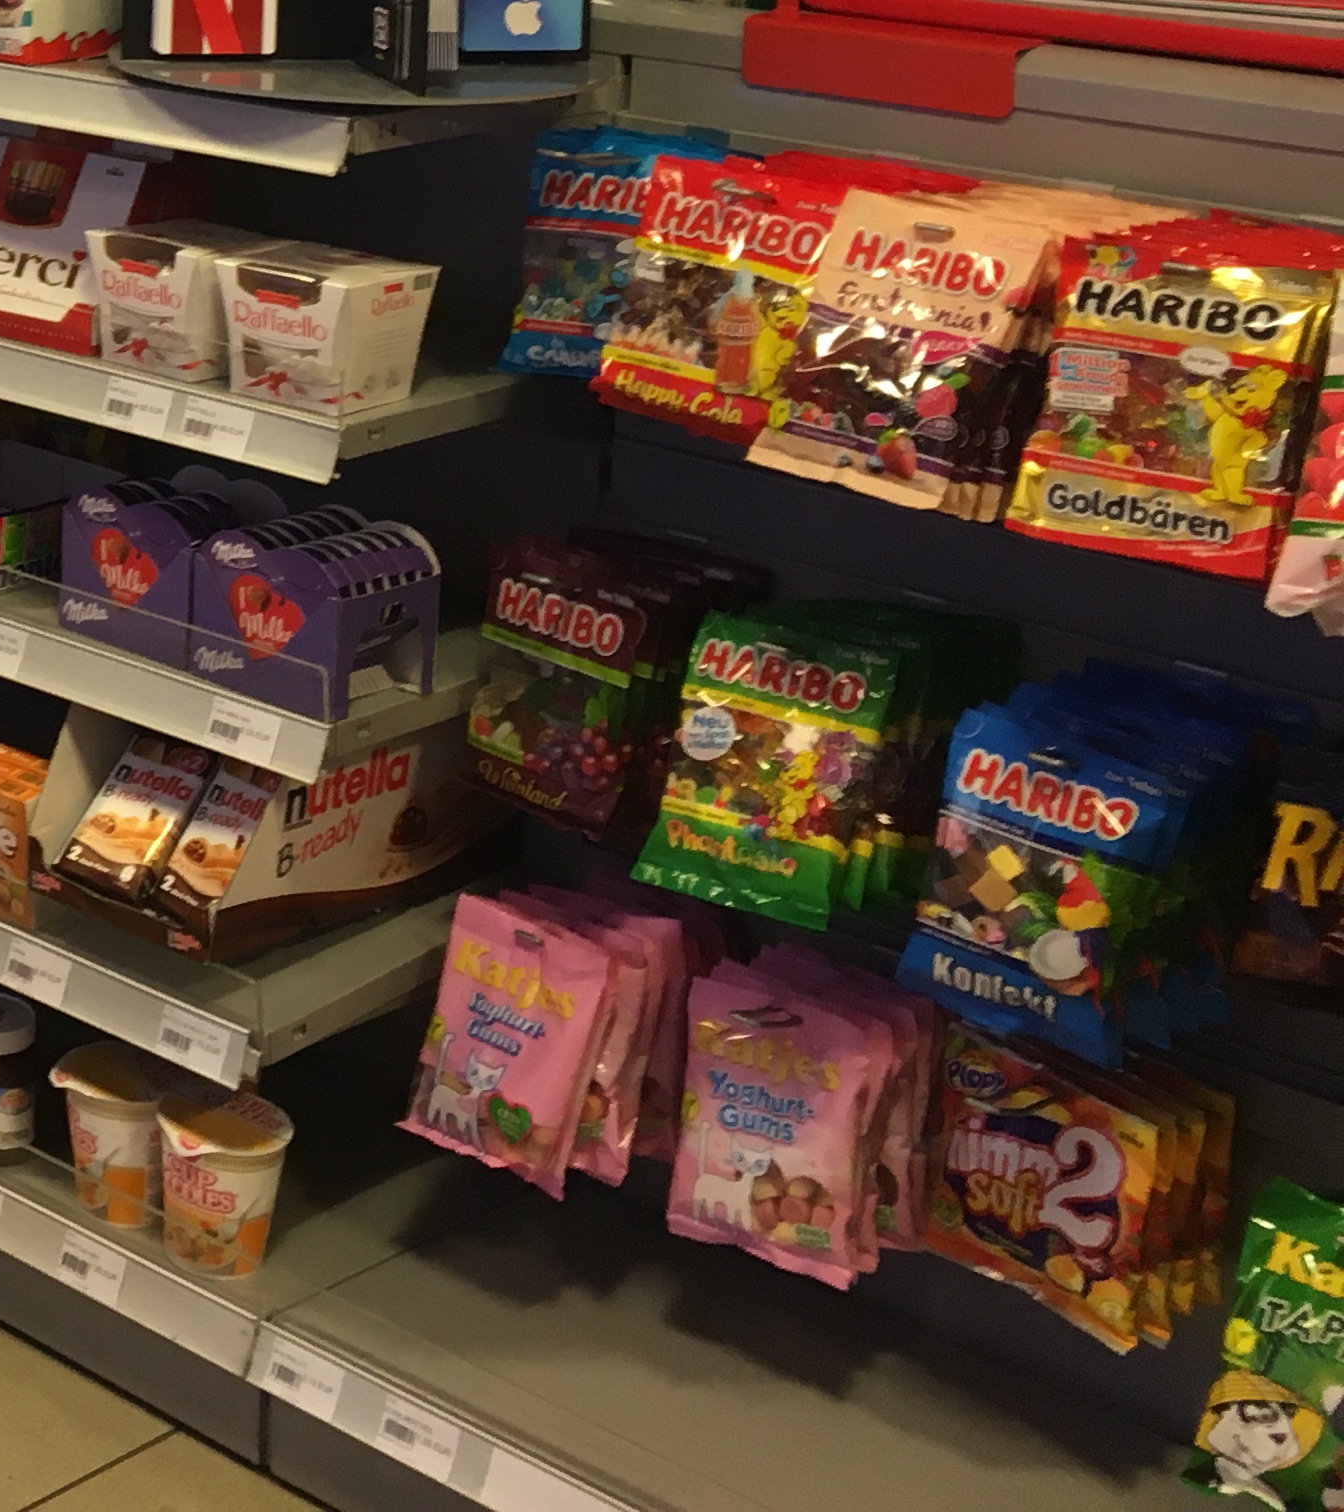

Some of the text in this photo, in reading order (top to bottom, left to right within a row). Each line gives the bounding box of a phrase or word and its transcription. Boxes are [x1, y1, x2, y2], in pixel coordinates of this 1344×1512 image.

[655, 191, 832, 265] HARIBO
[101, 269, 183, 310] Raffaello
[843, 228, 1008, 298] HARIBO
[232, 300, 329, 343] Raffaello
[1074, 279, 1286, 342] HARIBO
[1047, 482, 1233, 544] Goldbären
[63, 598, 109, 623] Milka
[100, 564, 150, 595] Milka
[239, 611, 293, 642] Milka
[495, 578, 625, 657] HARIBO
[194, 646, 245, 671] Milka
[694, 638, 868, 713] HARIBO
[114, 762, 195, 803] nutella
[207, 782, 273, 823] nutell
[282, 746, 414, 830] nutella
[957, 747, 1139, 841] HARIBO
[275, 808, 364, 879] B-ready
[451, 938, 577, 1021] Katjes
[931, 951, 1057, 1021] Konfekt
[466, 1019, 523, 1057] Gums
[694, 1019, 842, 1092] Katjes
[717, 1103, 796, 1143] Gums
